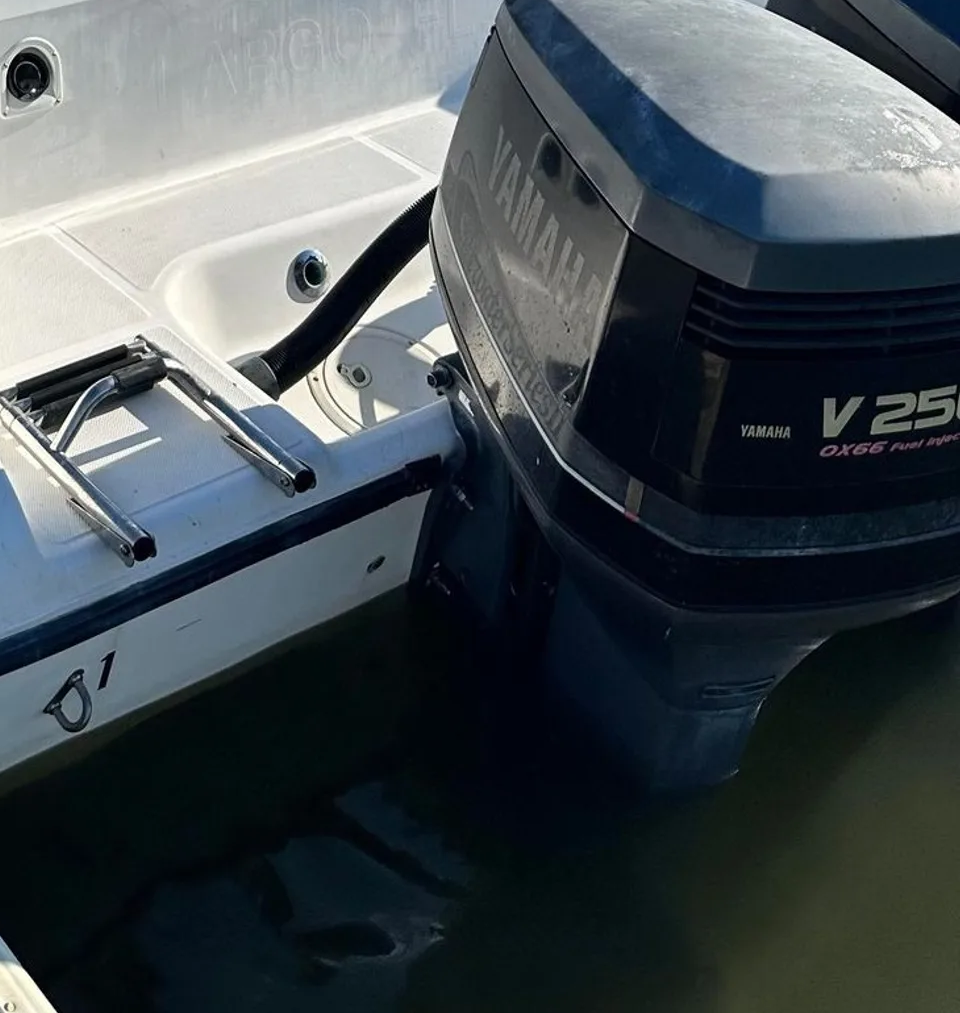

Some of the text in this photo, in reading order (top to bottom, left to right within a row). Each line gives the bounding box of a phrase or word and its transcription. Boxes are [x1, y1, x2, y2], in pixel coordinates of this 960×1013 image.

[489, 124, 603, 316] YAMAHA
[740, 424, 791, 439] YAMAHA
[823, 384, 960, 438] V 25
